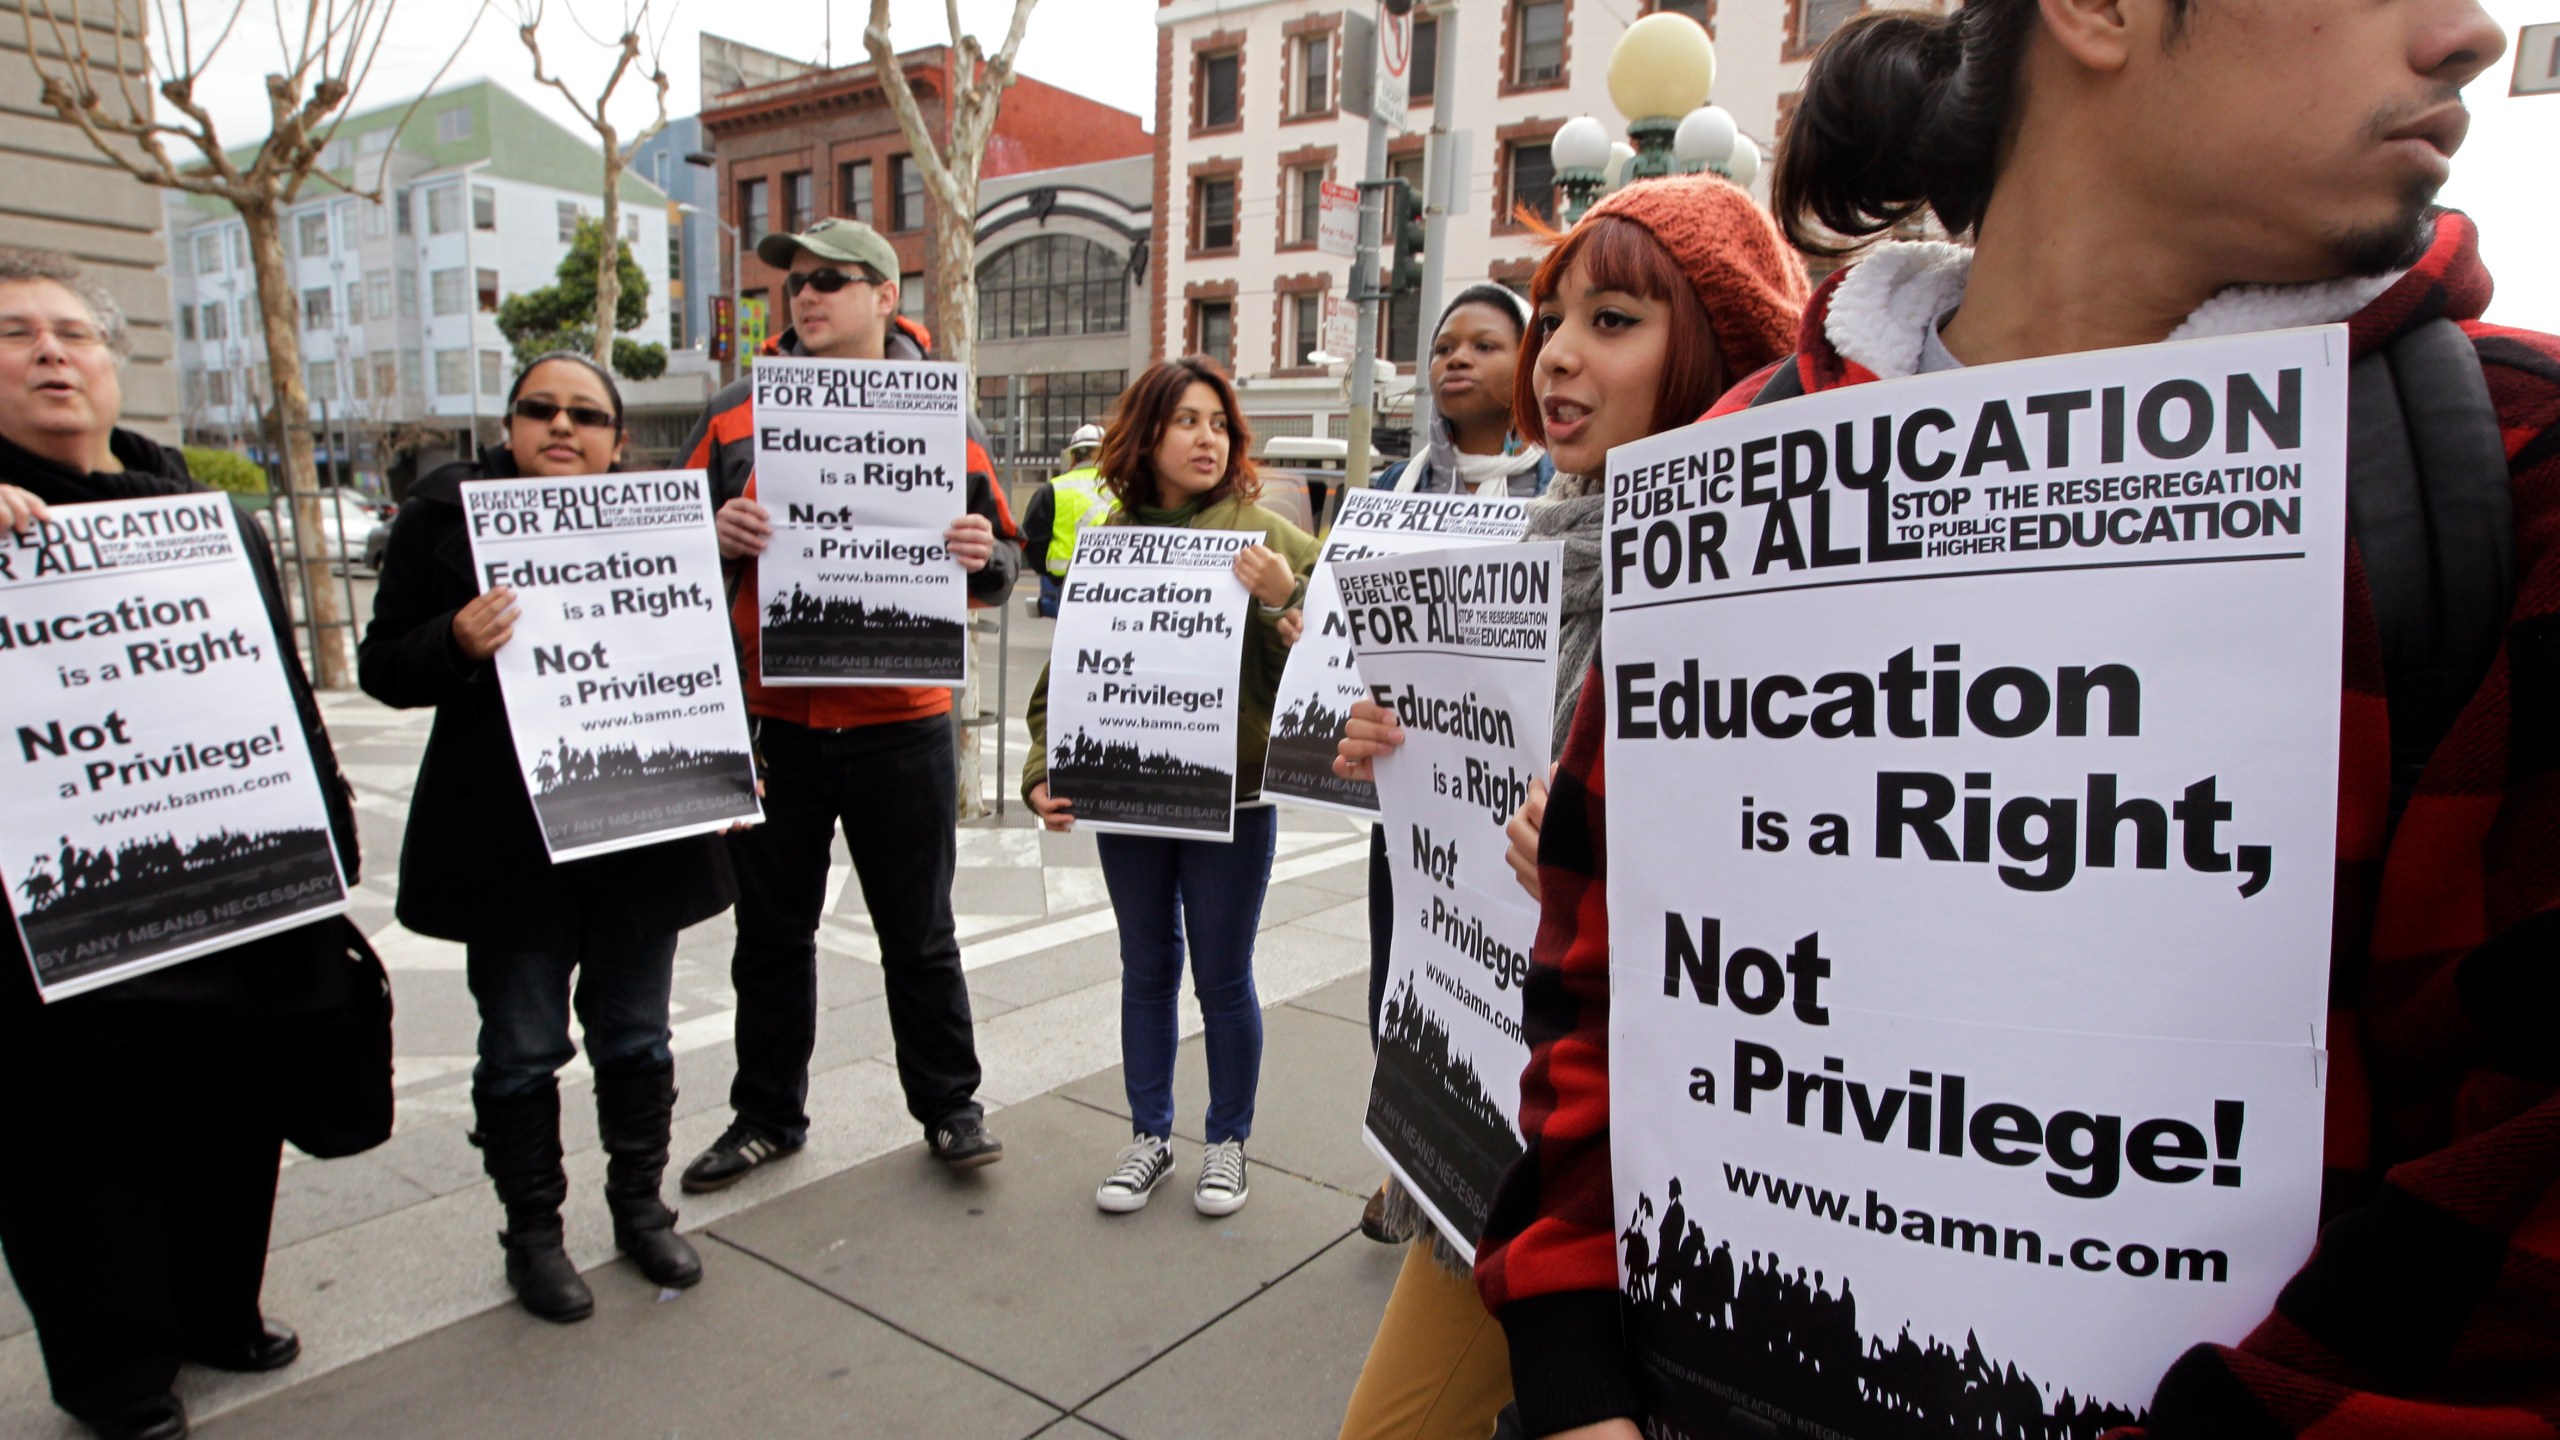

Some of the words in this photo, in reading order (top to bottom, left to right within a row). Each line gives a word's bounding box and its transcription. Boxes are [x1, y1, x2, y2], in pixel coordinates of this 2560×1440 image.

[817, 368, 958, 391] EDUCATION
[757, 385, 813, 406] FOR
[823, 385, 875, 408] ALL
[895, 400, 958, 411] EDUCATION
[761, 427, 926, 455] Education
[1740, 367, 2303, 508] EDUCATION
[820, 469, 838, 485] is
[844, 472, 857, 485] a
[863, 462, 954, 492] Right,
[1613, 447, 1735, 499] DEFEND
[541, 480, 701, 509] EDUCATION
[1611, 474, 1735, 526] PUBLIC
[1891, 487, 1972, 521] STOP
[1983, 485, 2040, 512] THE
[2046, 463, 2303, 507] RESEGREGATION
[473, 511, 541, 537] FOR
[553, 505, 613, 531] ALL
[788, 503, 853, 530] Not
[1339, 510, 1393, 529] FOR
[1398, 512, 1447, 532] ALL
[1897, 524, 1925, 542] TO
[1928, 516, 2007, 539] PUBLIC
[2009, 496, 2302, 552] EDUCATION
[802, 547, 814, 558] a
[1128, 533, 1257, 551] EDUCATION
[1610, 510, 1731, 597] FOR
[1751, 481, 1923, 577] ALL
[1926, 536, 2006, 559] HIGHER
[36, 541, 118, 577] ALL
[484, 552, 677, 588] Education
[1075, 548, 1122, 565] FOR
[1128, 545, 1174, 565] ALL
[817, 571, 949, 585] www.bamn.com
[1067, 582, 1212, 603] Education
[1339, 570, 1408, 591] DEFEND
[1408, 560, 1550, 605] EDUCATION
[563, 602, 584, 620] is
[591, 603, 605, 618] a
[610, 581, 713, 618] Right,
[1343, 586, 1411, 606] PUBLIC
[1111, 617, 1127, 631] is
[1132, 619, 1144, 632] a
[1149, 610, 1232, 639] Right,
[1347, 605, 1419, 646] FOR
[1427, 600, 1465, 645] ALL
[1458, 608, 1474, 624] STOP
[1476, 610, 1488, 624] THE
[1488, 611, 1548, 626] RESEGREGATION
[1481, 628, 1547, 650] EDUCATION
[58, 666, 90, 688] is
[99, 662, 122, 681] a
[126, 628, 261, 677] Right,
[533, 640, 609, 677] Not
[819, 655, 870, 667] MEANS
[874, 656, 962, 668] NECESSARY
[1076, 648, 1136, 675] Not
[1327, 656, 1339, 668] a
[560, 692, 573, 707] a
[577, 663, 723, 704] Privilege!
[1087, 691, 1097, 702] a
[1102, 682, 1223, 712] Privilege!
[1614, 643, 2141, 740] Education
[582, 700, 725, 731] www.bamn.com
[1099, 716, 1220, 732] www.bamn.com
[1370, 684, 1515, 749] Education
[16, 710, 131, 763] Not
[59, 782, 79, 799] a
[85, 725, 285, 792] Privilege!
[93, 769, 291, 826] www.bamn.com
[1320, 775, 1372, 797] MEANS
[1434, 763, 1447, 795] is
[1451, 773, 1462, 800] a
[1465, 756, 1532, 826] Righ
[1099, 800, 1144, 814] MEANS
[1147, 804, 1228, 819] NECESSARY
[1741, 795, 1790, 853] is
[1807, 811, 1850, 856] a
[1875, 770, 2273, 900] Right,
[1412, 823, 1458, 889] Not
[75, 933, 122, 960] ANY
[128, 909, 209, 945] MEANS
[212, 873, 337, 922] NECESSARY
[1421, 907, 1429, 931] a
[1663, 910, 1831, 1026] Not
[1687, 1065, 1716, 1105] a
[1732, 1038, 2245, 1199] Privilege!
[1435, 1155, 1489, 1221] NECESSA
[1721, 1161, 2229, 1283] www.bamn.com
